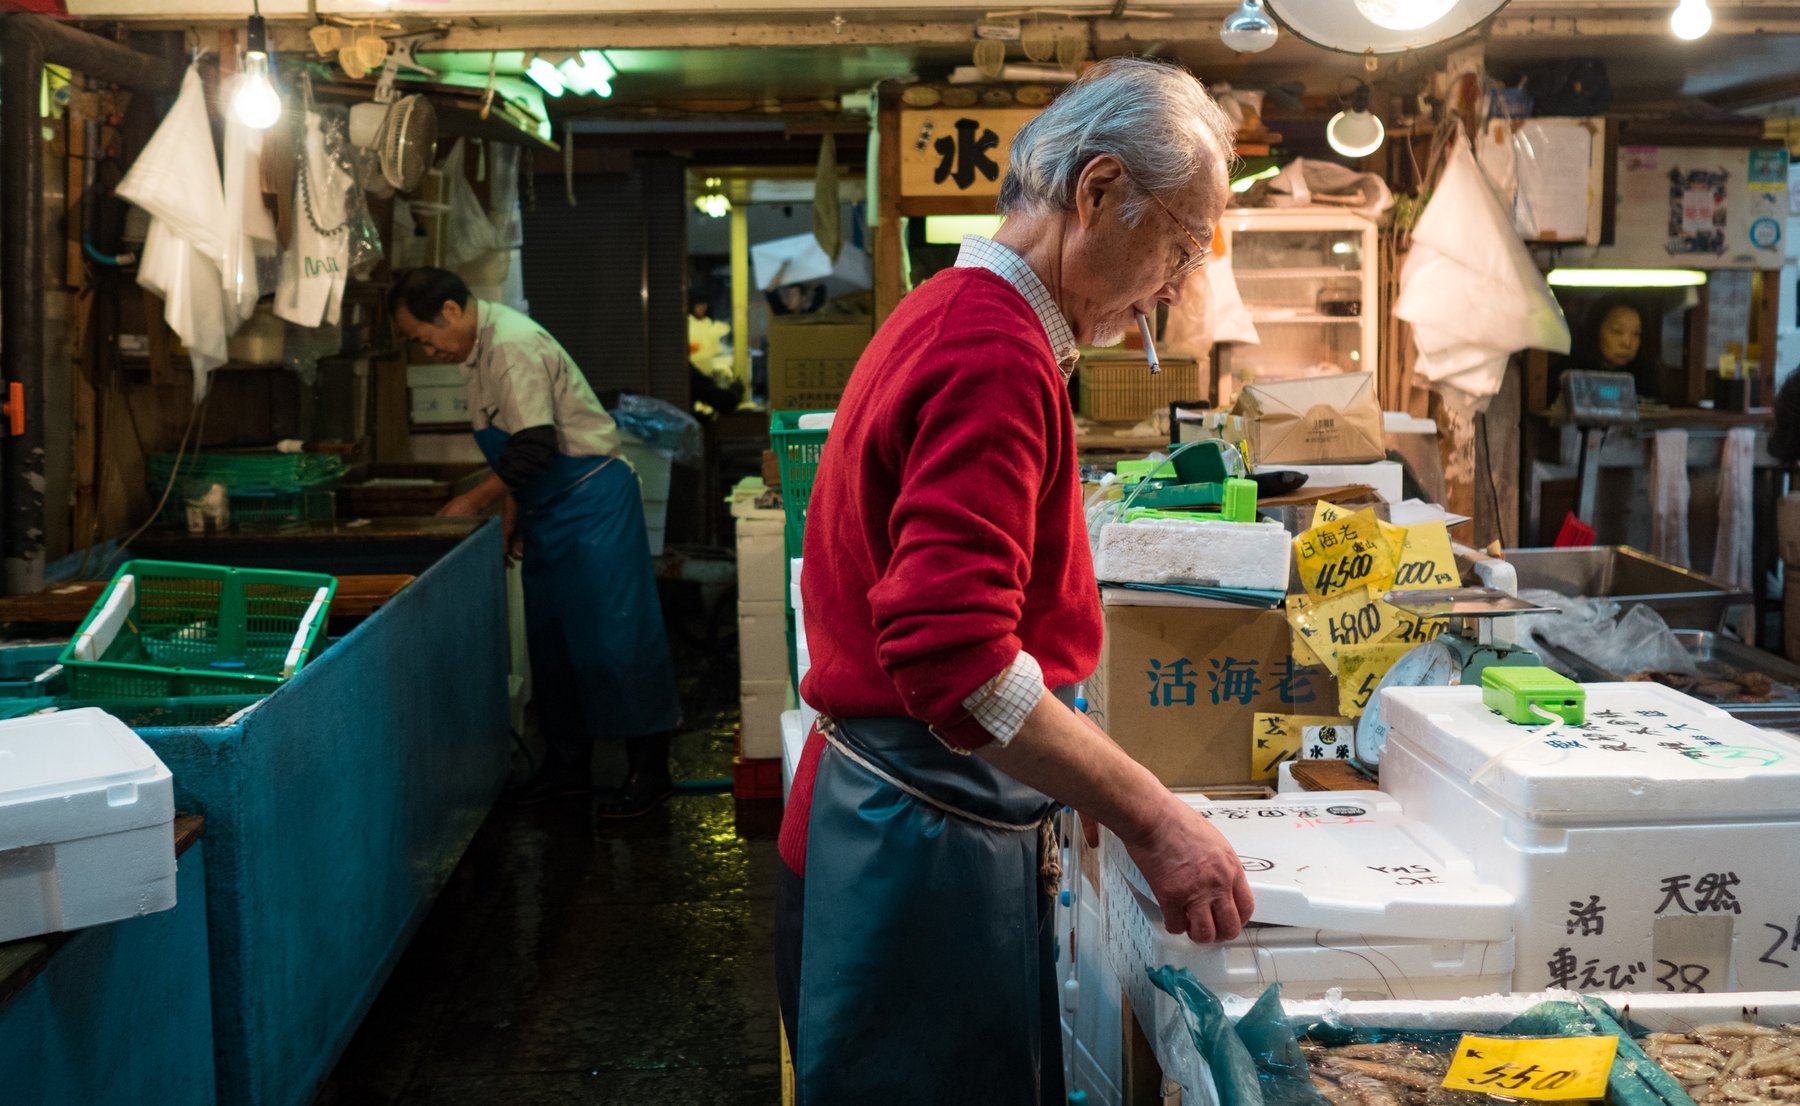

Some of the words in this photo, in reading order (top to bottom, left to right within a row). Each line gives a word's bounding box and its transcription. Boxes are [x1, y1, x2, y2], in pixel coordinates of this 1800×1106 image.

[933, 117, 999, 191] 水
[1316, 553, 1374, 596] 4500
[1146, 655, 1319, 708] 活海老
[1309, 744, 1350, 760] 水栄
[1653, 871, 1743, 915] 天然
[1565, 895, 1607, 937] 活
[1546, 947, 1647, 991] 車えび
